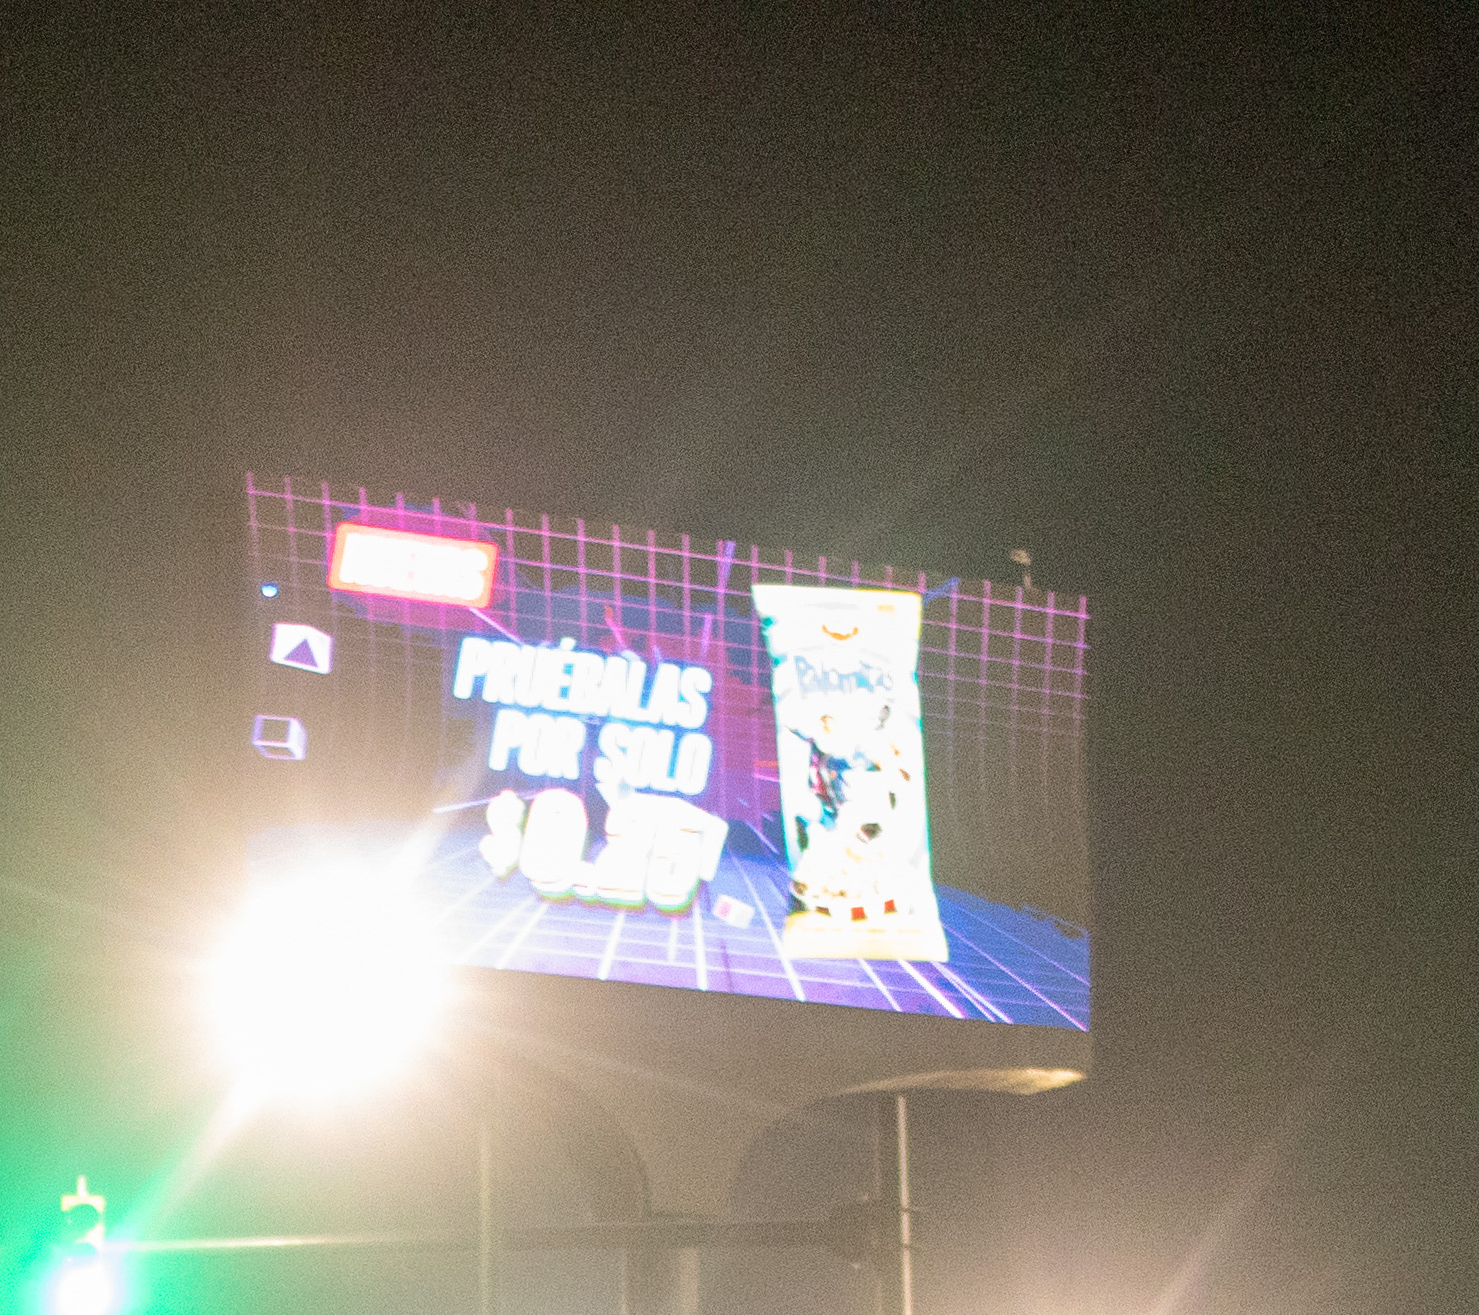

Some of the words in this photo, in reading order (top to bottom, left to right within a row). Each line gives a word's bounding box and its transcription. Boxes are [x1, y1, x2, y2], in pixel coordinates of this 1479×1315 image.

[452, 636, 714, 730] PRUÉBALAS
[488, 708, 587, 781] POR
[593, 722, 714, 796] SOLO
